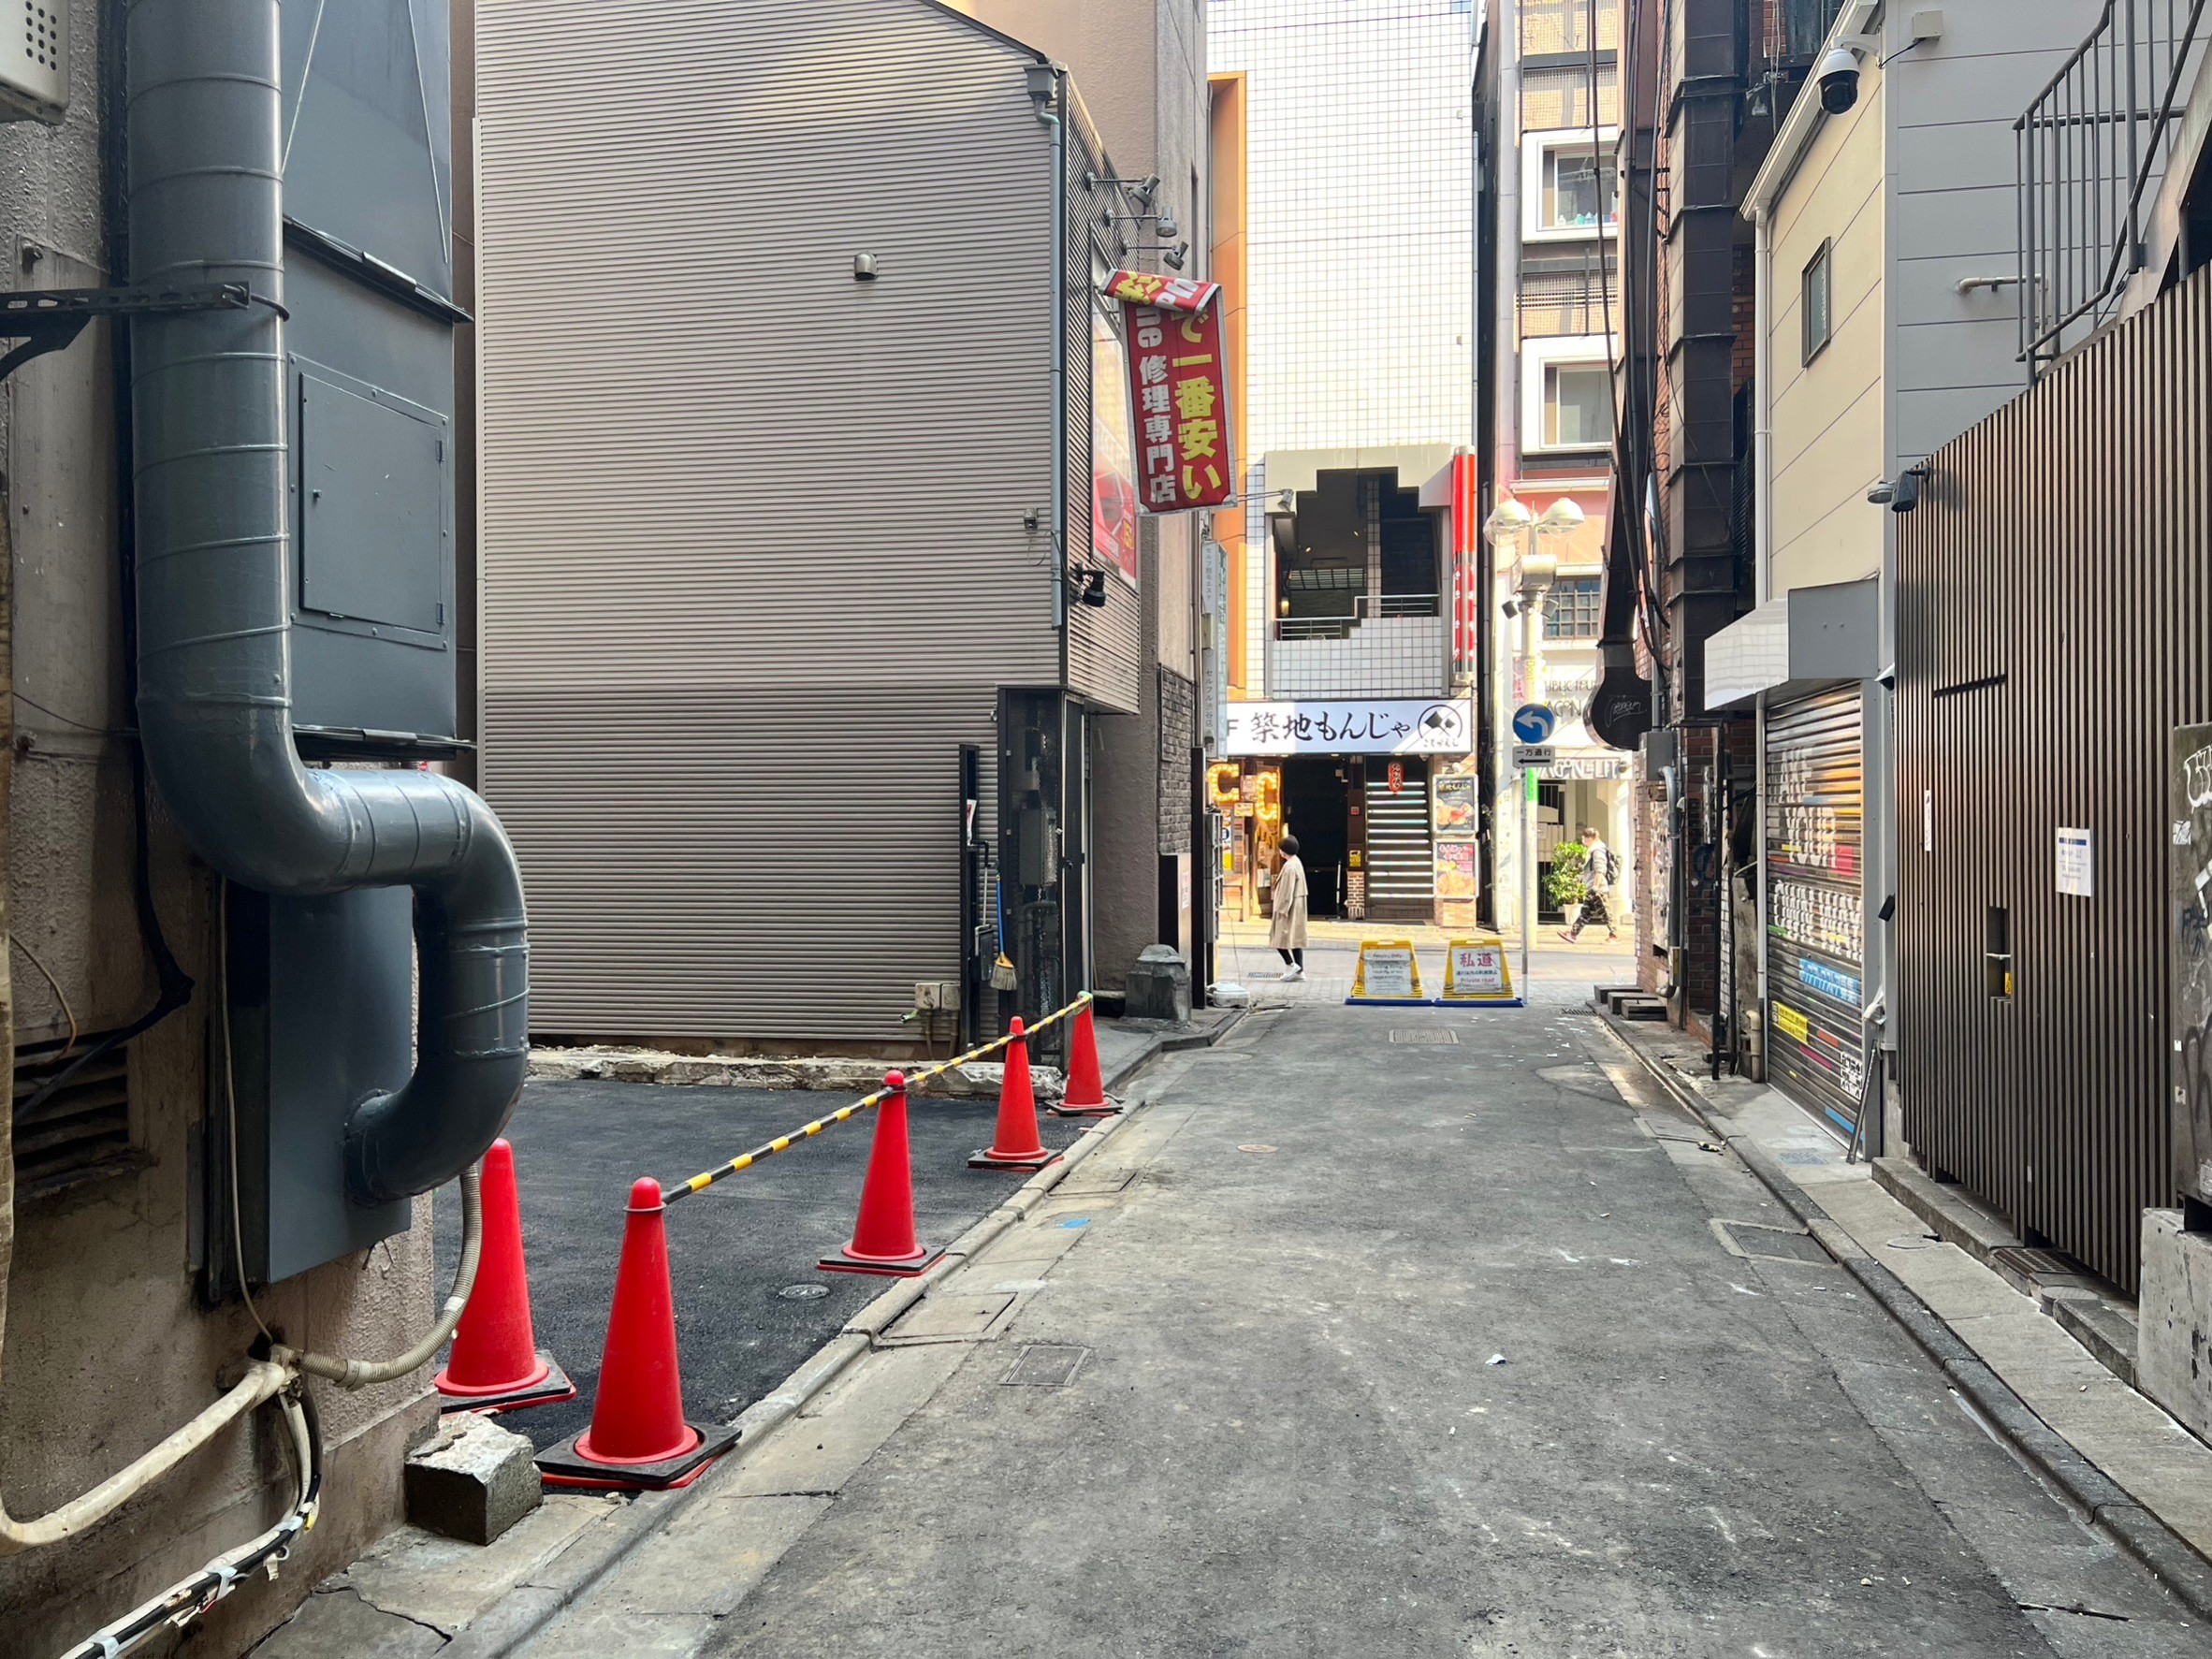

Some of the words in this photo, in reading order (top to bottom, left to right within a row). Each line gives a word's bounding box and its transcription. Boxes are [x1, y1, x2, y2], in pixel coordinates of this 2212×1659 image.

[1250, 711, 1411, 744] 築地もんじゃ
[1784, 806, 1836, 868] YOUR
[1460, 953, 1492, 968] 私道
